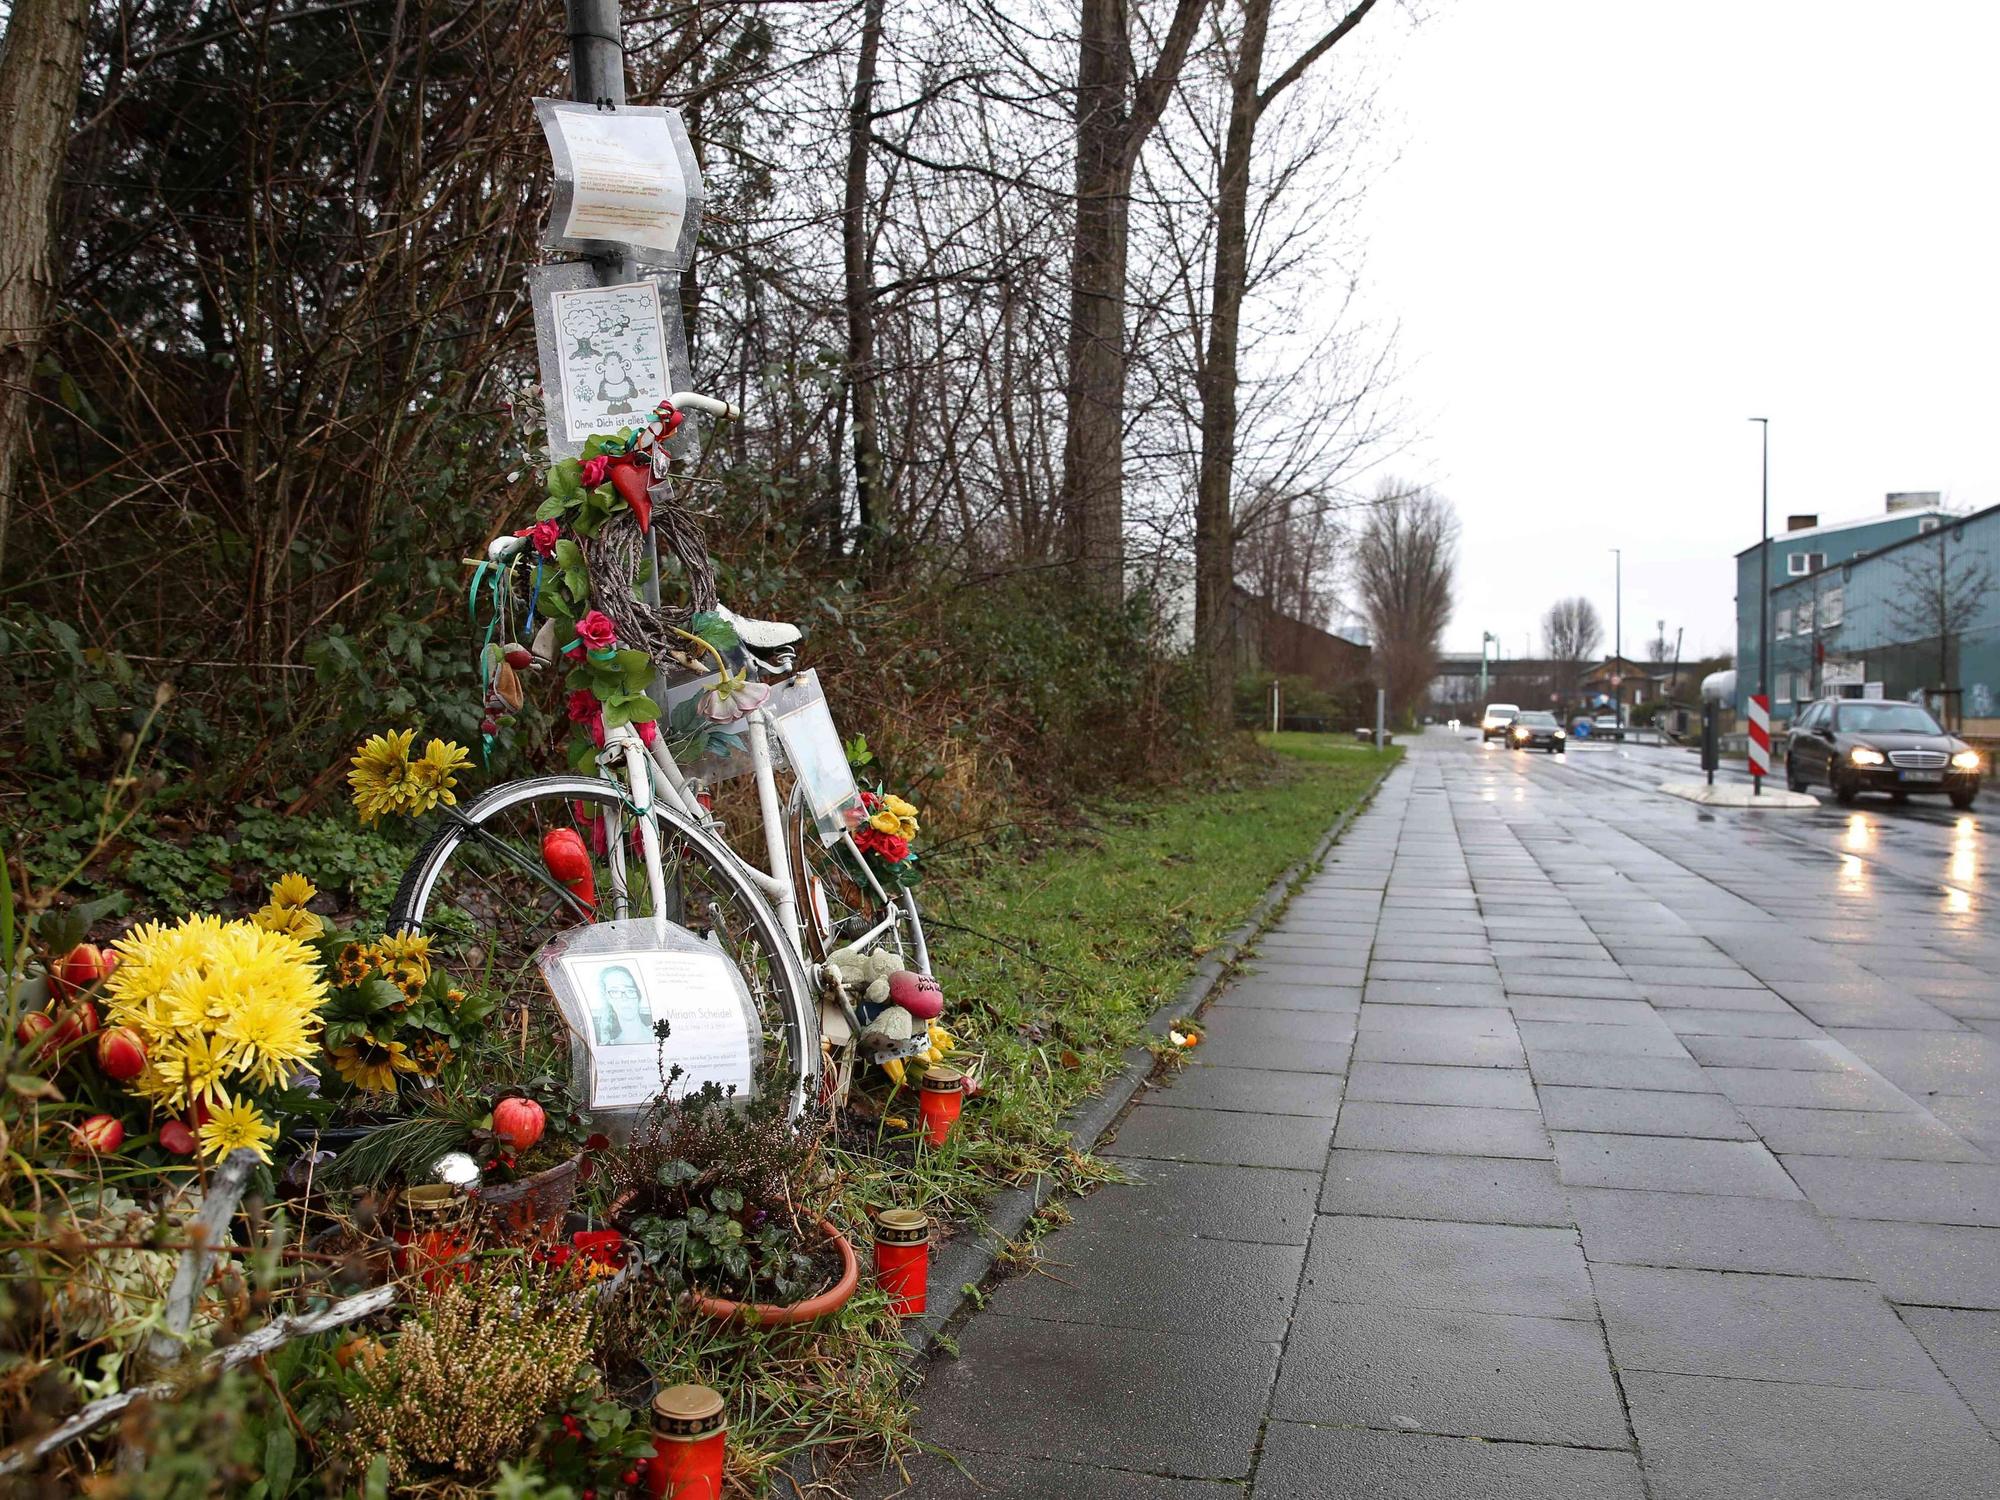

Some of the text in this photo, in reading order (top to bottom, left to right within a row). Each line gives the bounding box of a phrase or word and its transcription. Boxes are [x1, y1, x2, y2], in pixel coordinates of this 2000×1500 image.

[574, 415, 645, 430] Ohne Dich ist alles
